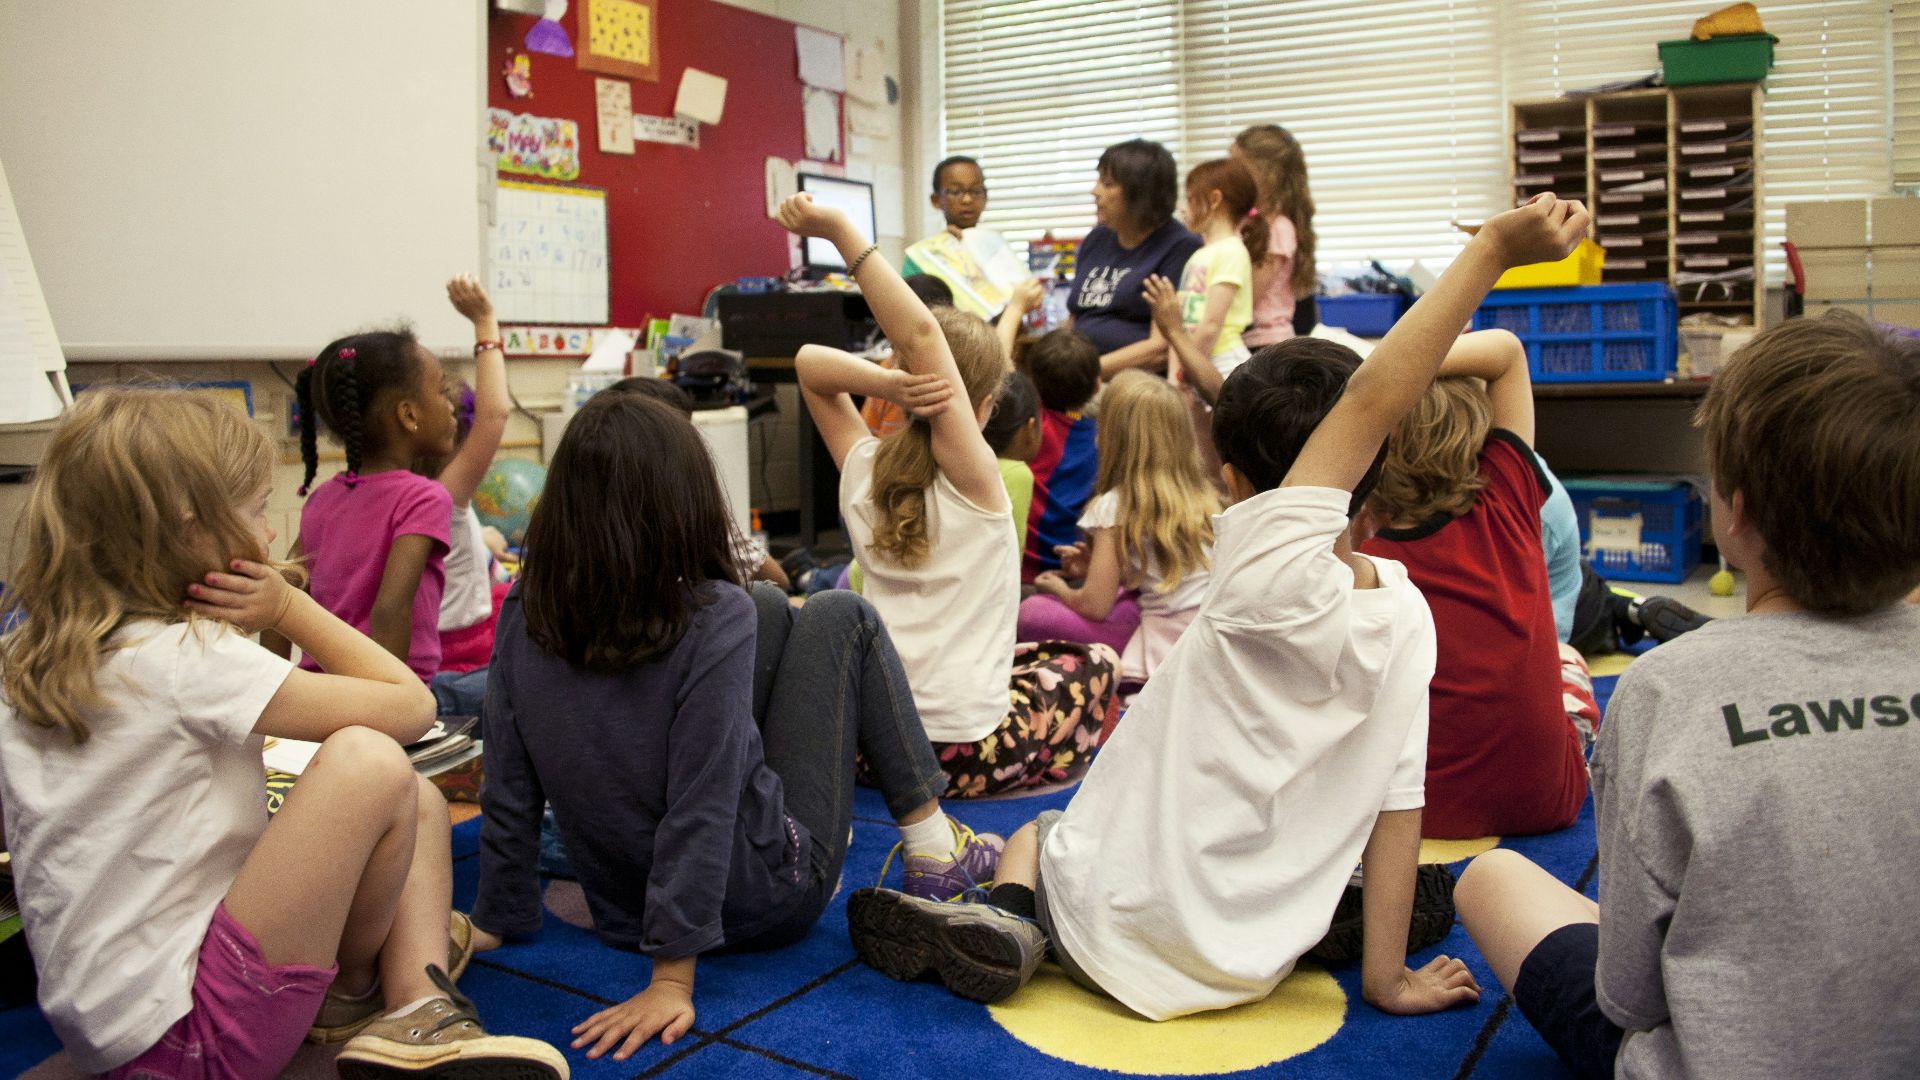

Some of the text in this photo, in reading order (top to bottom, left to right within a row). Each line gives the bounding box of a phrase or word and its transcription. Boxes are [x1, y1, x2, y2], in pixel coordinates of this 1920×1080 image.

[507, 332, 581, 349] A B C
[1721, 693, 1920, 748] Laws
